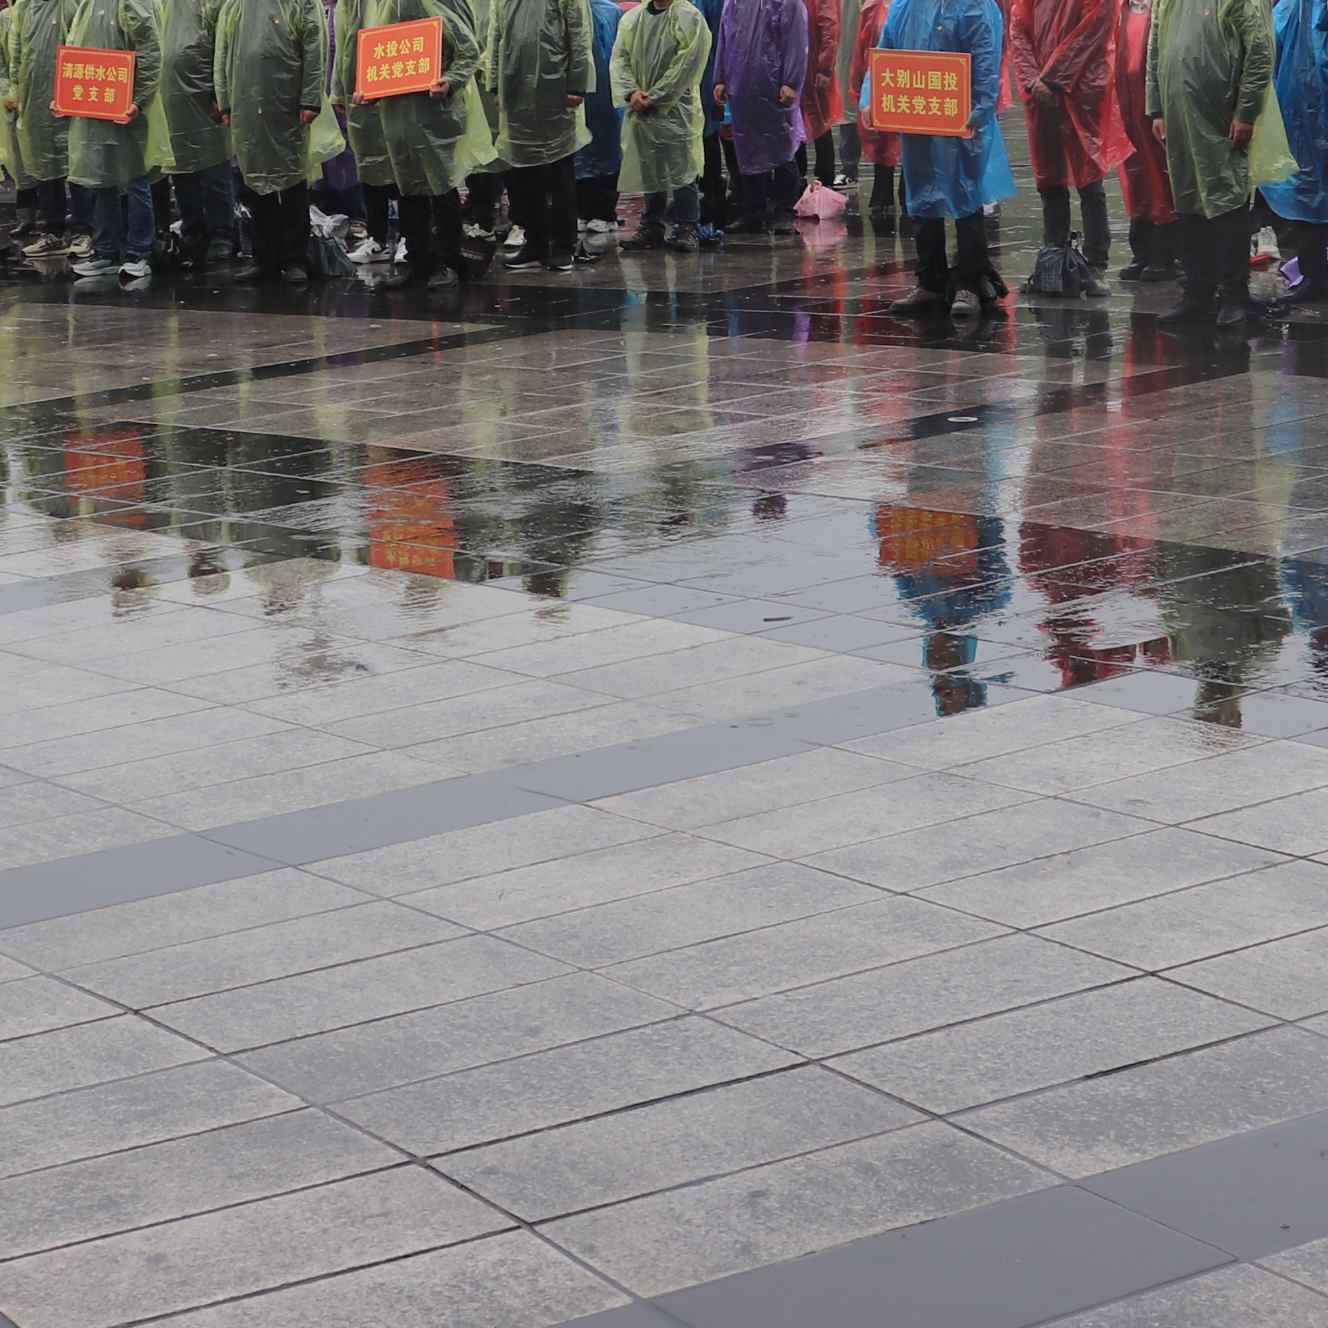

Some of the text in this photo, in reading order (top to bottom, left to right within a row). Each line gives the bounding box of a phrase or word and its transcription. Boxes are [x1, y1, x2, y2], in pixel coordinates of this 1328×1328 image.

[373, 36, 424, 60] 水投公司
[366, 57, 431, 83] 机关党支部
[880, 67, 959, 91] 大别山国投
[72, 83, 115, 104] 党支部
[880, 93, 959, 118] 机关党支部
